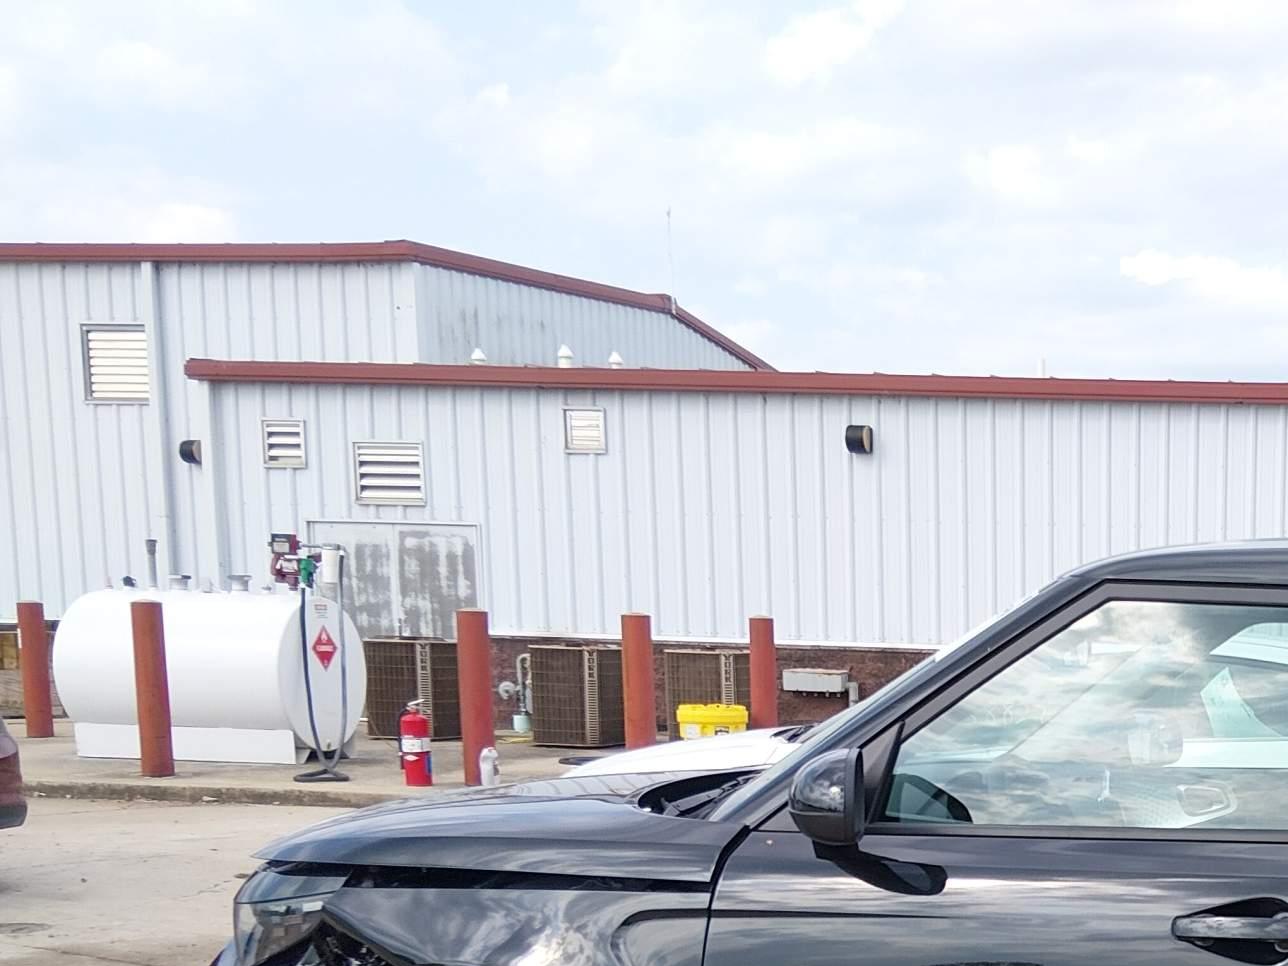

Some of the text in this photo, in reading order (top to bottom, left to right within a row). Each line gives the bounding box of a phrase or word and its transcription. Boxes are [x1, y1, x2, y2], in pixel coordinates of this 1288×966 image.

[419, 643, 429, 672] YORK
[587, 649, 596, 679] YORK
[723, 653, 733, 683] YORK
